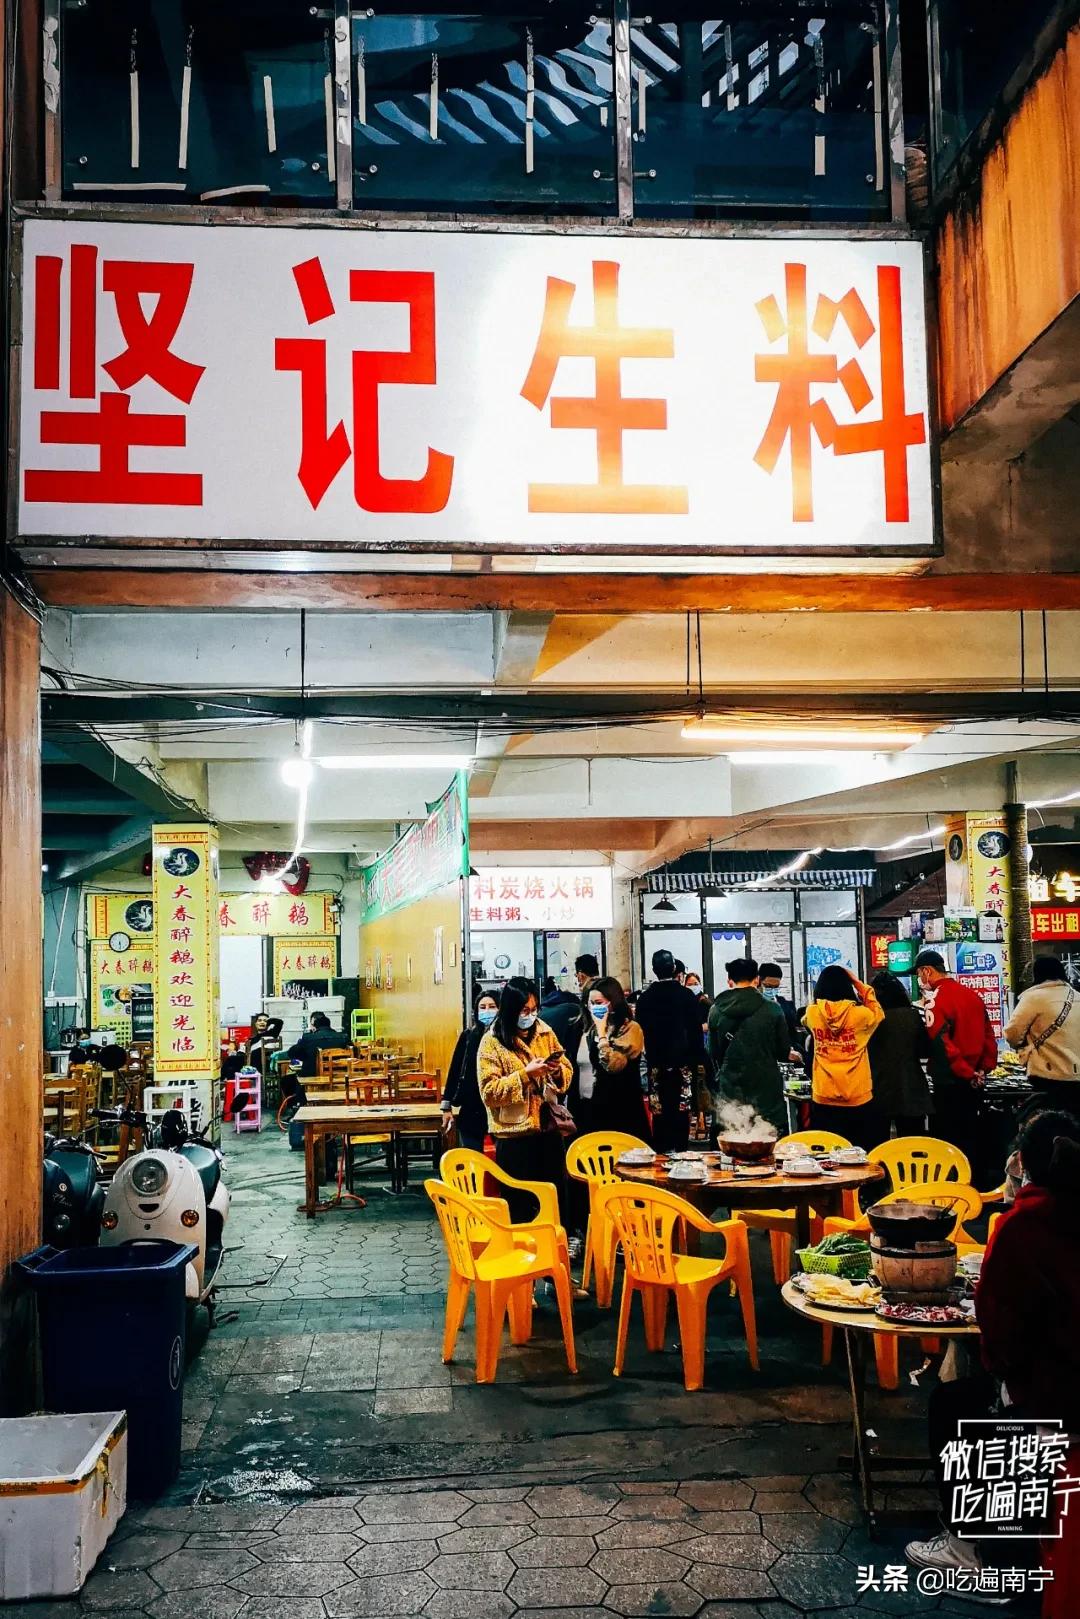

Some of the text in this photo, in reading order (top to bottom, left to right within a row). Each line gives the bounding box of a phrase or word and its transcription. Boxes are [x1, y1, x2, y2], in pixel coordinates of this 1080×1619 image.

[24, 243, 926, 523] 坚记生料
[169, 884, 196, 1053] 大春醉鹅欢迎光临
[281, 953, 331, 971] 大春醉鹅
[1031, 912, 1080, 934] 车出租
